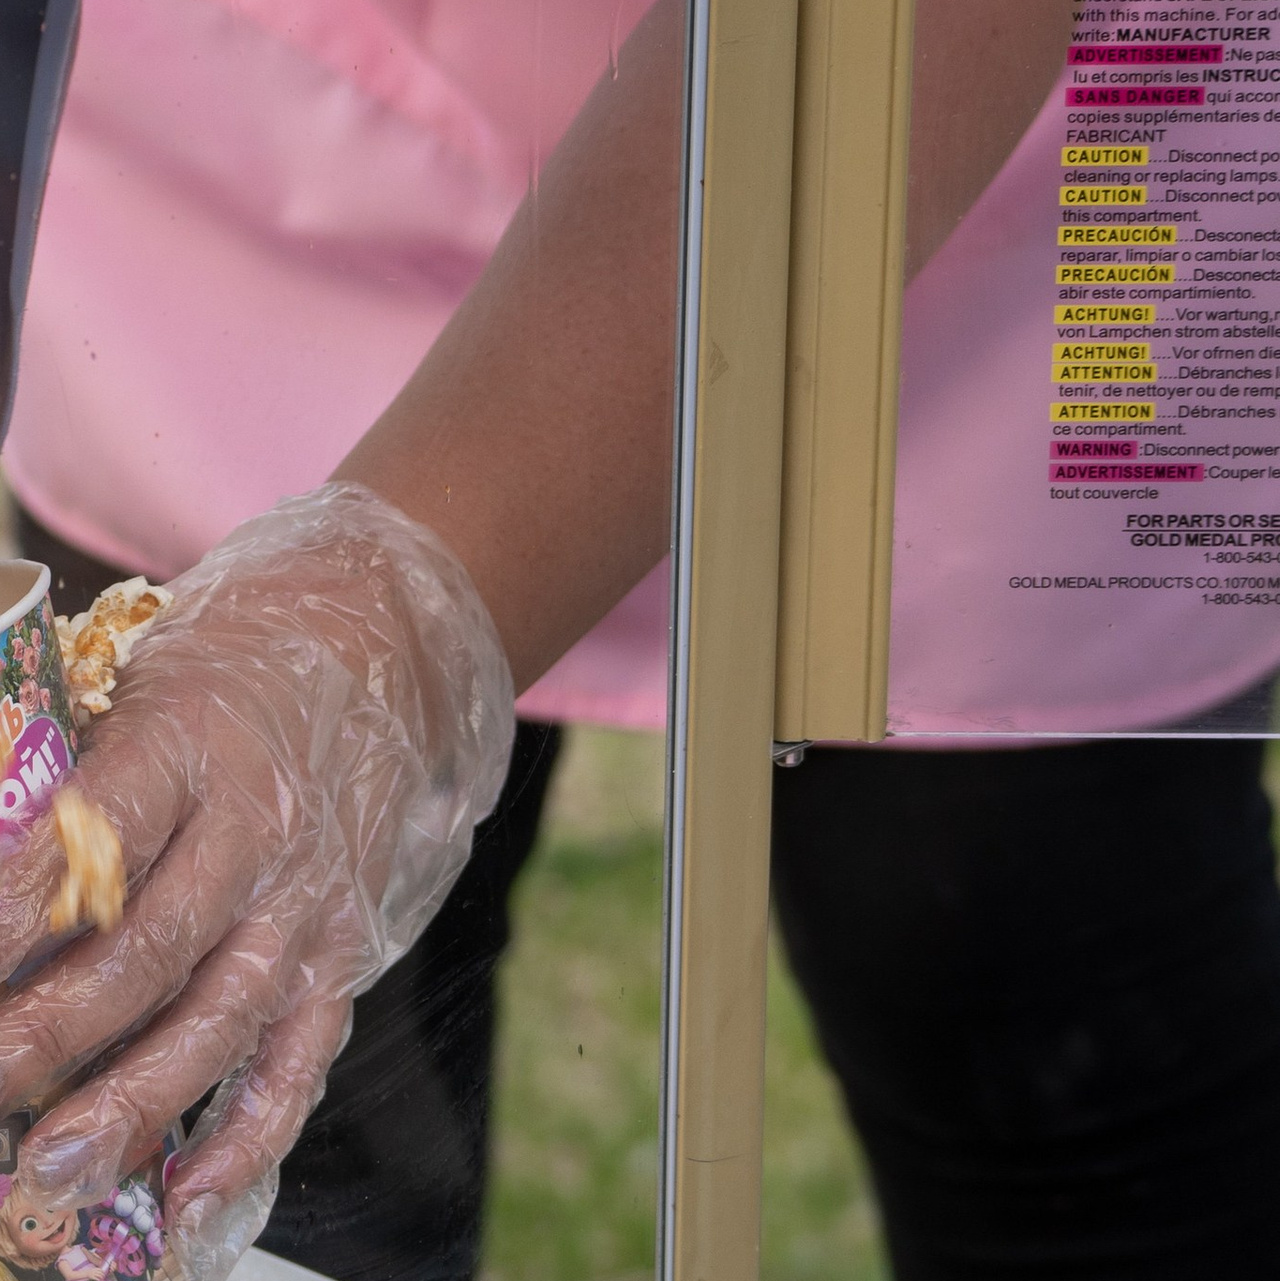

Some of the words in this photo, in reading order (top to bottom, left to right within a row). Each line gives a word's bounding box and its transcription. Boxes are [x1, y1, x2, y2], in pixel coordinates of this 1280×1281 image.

[1072, 9, 1105, 22] with
[1110, 8, 1139, 22] this
[1144, 8, 1220, 22] machine.
[1225, 7, 1253, 21] For
[1073, 47, 1220, 63] ADVERTISSEMENT
[1091, 72, 1106, 83] et
[1109, 70, 1172, 86] compris
[1176, 70, 1199, 83] les
[1074, 90, 1120, 104] SANS
[1126, 89, 1200, 103] DANGER
[1206, 90, 1231, 106] qui
[1067, 111, 1120, 126] copies
[1066, 129, 1167, 143] FABRICANT
[1067, 150, 1142, 163] CAUTION
[1064, 170, 1130, 185] cleaning
[1134, 173, 1150, 182] or
[1154, 171, 1226, 185] replacing
[1065, 190, 1141, 203] CAUTION
[1062, 210, 1090, 222] this
[1094, 209, 1202, 225] compartment.
[1063, 227, 1171, 242] PRECAUCIÓN
[1061, 251, 1121, 264] reparar,
[1126, 249, 1178, 264] limpiar
[1181, 252, 1191, 261] o
[1195, 249, 1258, 261] cambiar
[1061, 266, 1169, 281] PRECAUCIÓN
[1059, 287, 1089, 299] abir
[1092, 288, 1126, 299] este
[1063, 308, 1149, 321] ACHTUNG!
[1057, 328, 1085, 338] von
[1175, 327, 1219, 337] strom
[1061, 346, 1145, 359] ACHTUNG!
[1060, 367, 1152, 379] ATTENTION
[1059, 385, 1098, 399] tenir,
[1102, 385, 1122, 397] de
[1126, 386, 1192, 400] nettoyer
[1196, 387, 1216, 397] ou
[1220, 385, 1239, 397] de
[1058, 406, 1151, 418] ATTENTION
[1052, 425, 1071, 436] ce
[1074, 423, 1186, 438] compartiment.
[1057, 443, 1132, 456] WARNING
[1055, 466, 1197, 479] ADVERTISSEMENT
[1050, 487, 1080, 499] tout
[1083, 487, 1159, 499] couvercle
[1126, 514, 1164, 528] FOR
[1166, 514, 1226, 528] PARTS
[1228, 514, 1255, 528] OR
[1130, 533, 1182, 547] GOLD
[1185, 533, 1248, 547] MEDAL
[1009, 577, 1052, 588] GOLD
[1054, 577, 1106, 588] MEDAL
[1108, 577, 1193, 588] PRODUCTS
